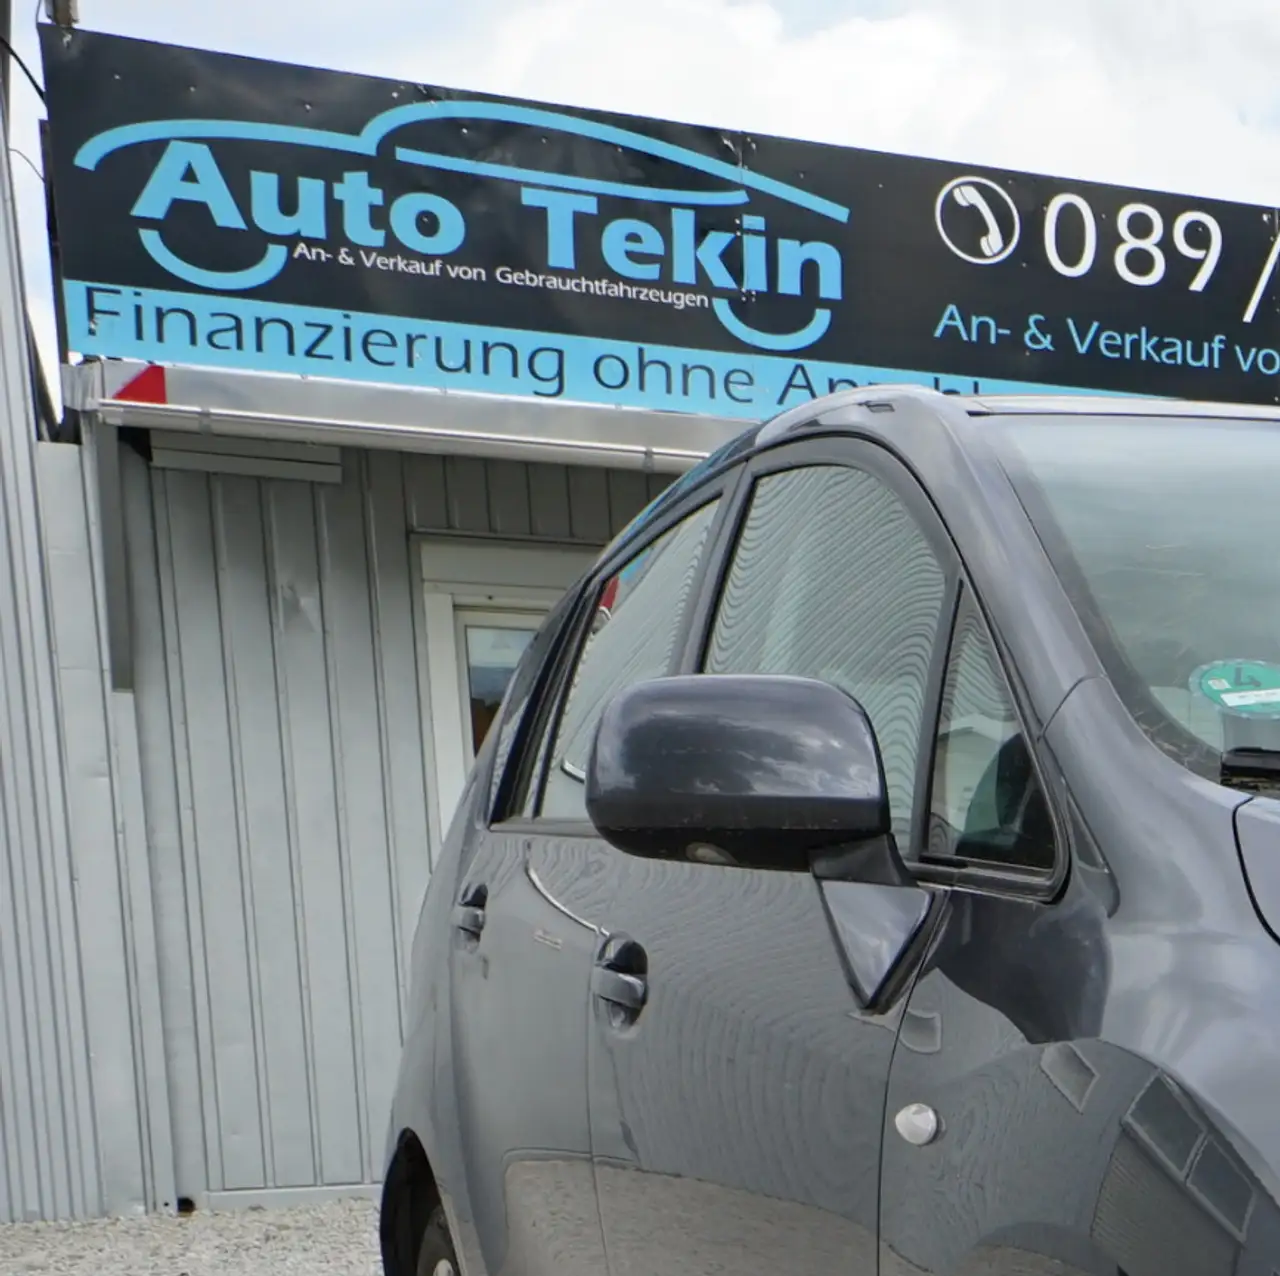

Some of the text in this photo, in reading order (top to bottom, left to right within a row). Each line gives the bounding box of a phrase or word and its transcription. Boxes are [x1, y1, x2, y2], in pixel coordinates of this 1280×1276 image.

[130, 139, 843, 300] Auto Tekin
[1044, 193, 1223, 292] 089
[293, 242, 709, 310] An- & Verkauf von Gebrauchtfahrzeugen
[85, 285, 566, 398] Finanzierung
[593, 347, 755, 403] ohne
[933, 303, 1011, 344] An-
[1023, 313, 1055, 351] &
[1066, 318, 1226, 369] Verkauf
